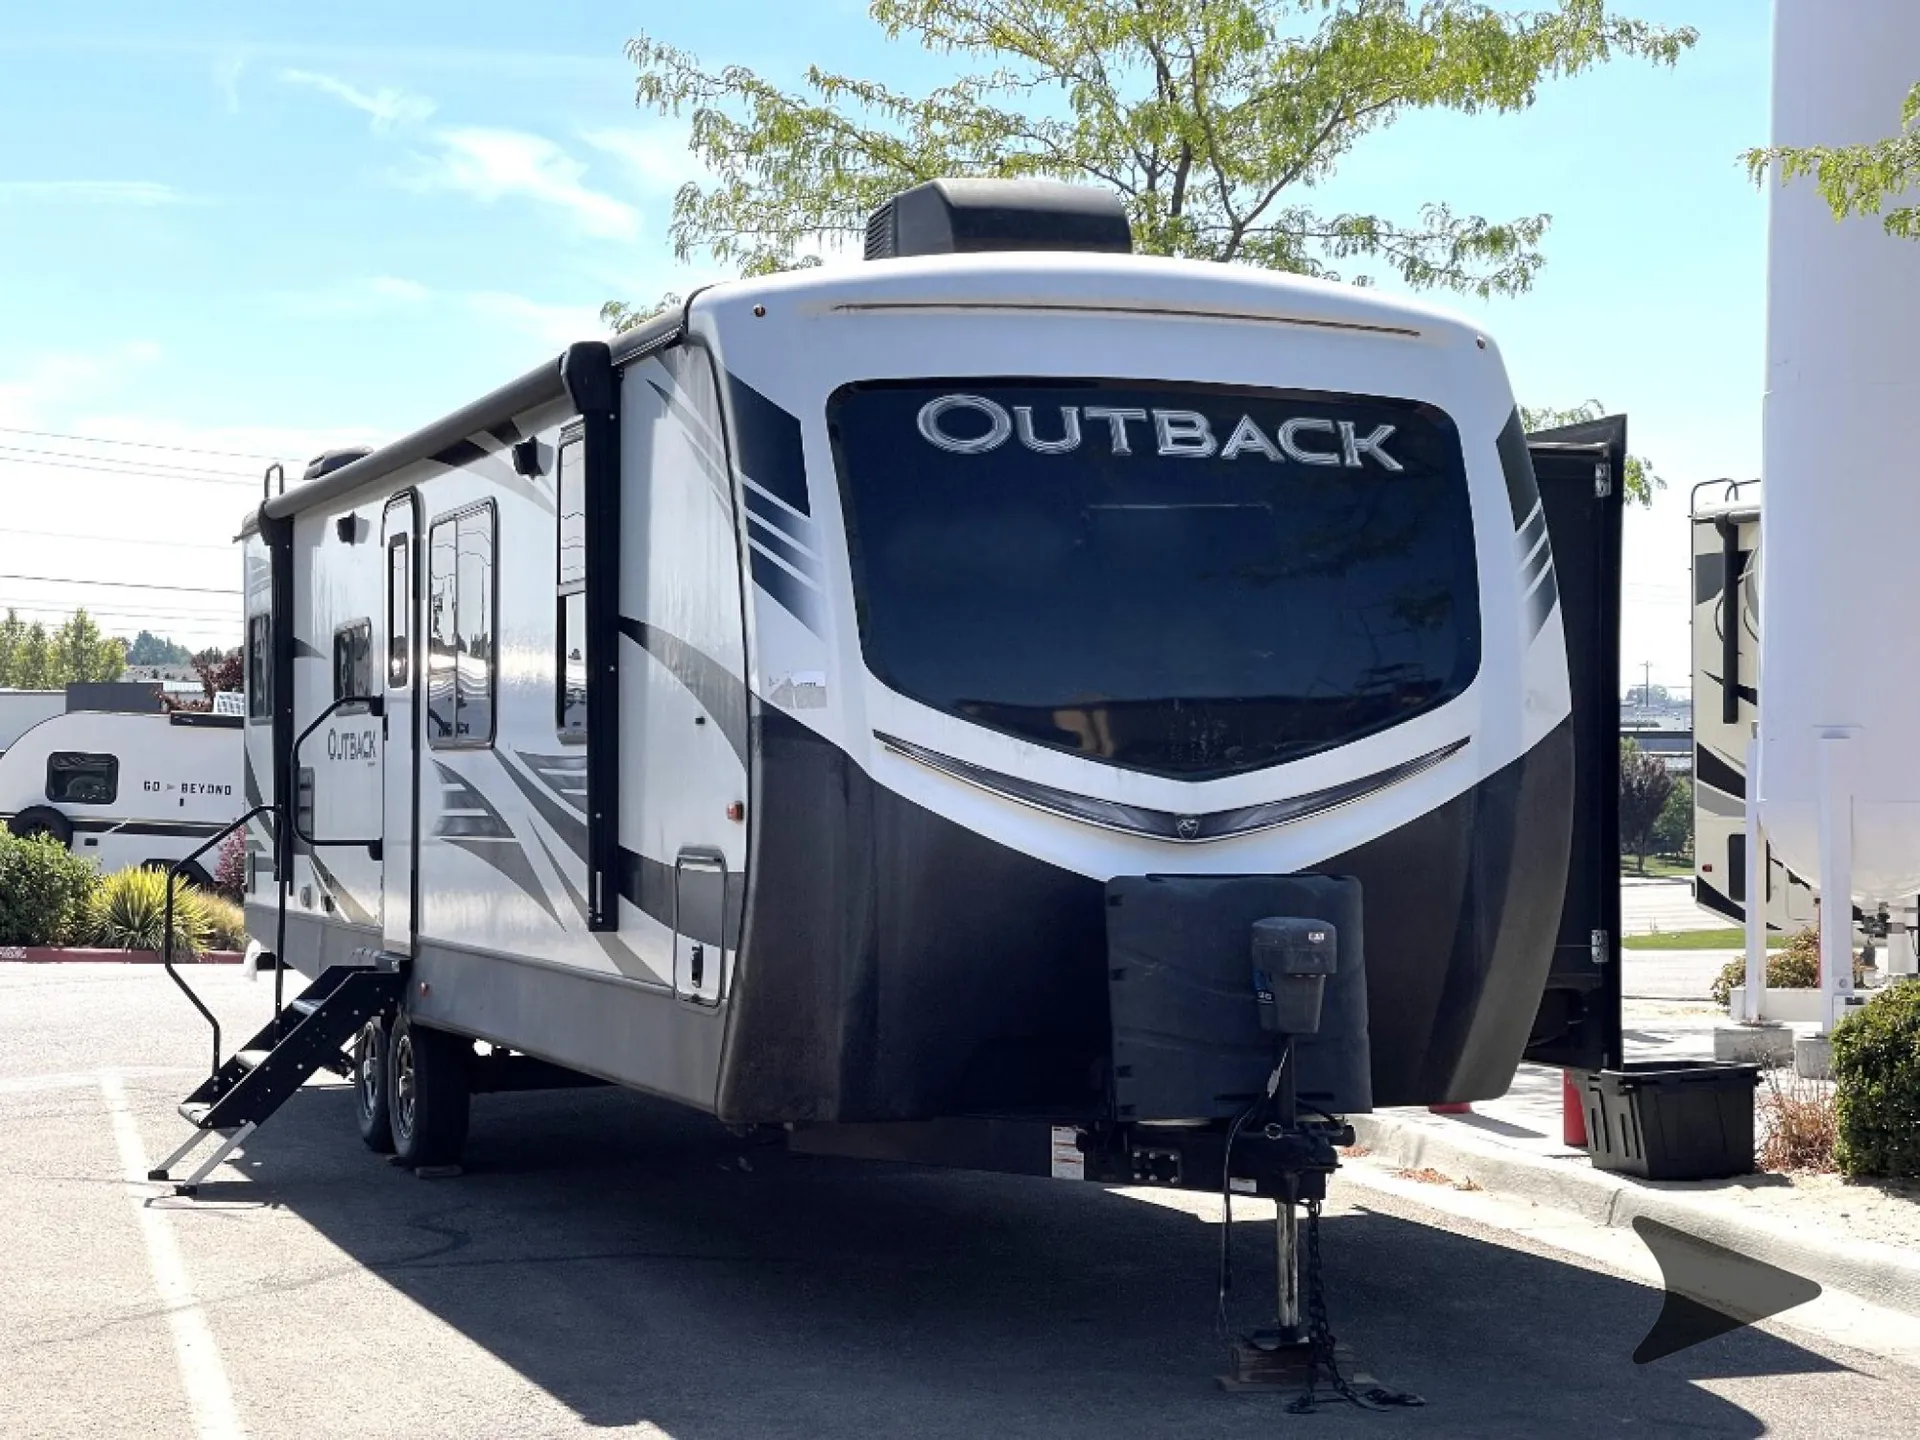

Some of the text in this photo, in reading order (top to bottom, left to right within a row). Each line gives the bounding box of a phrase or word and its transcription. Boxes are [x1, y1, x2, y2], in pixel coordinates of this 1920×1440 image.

[916, 394, 1404, 472] OUTBACK
[327, 727, 376, 761] OUTBACK
[143, 780, 232, 796] GO BEYOND
